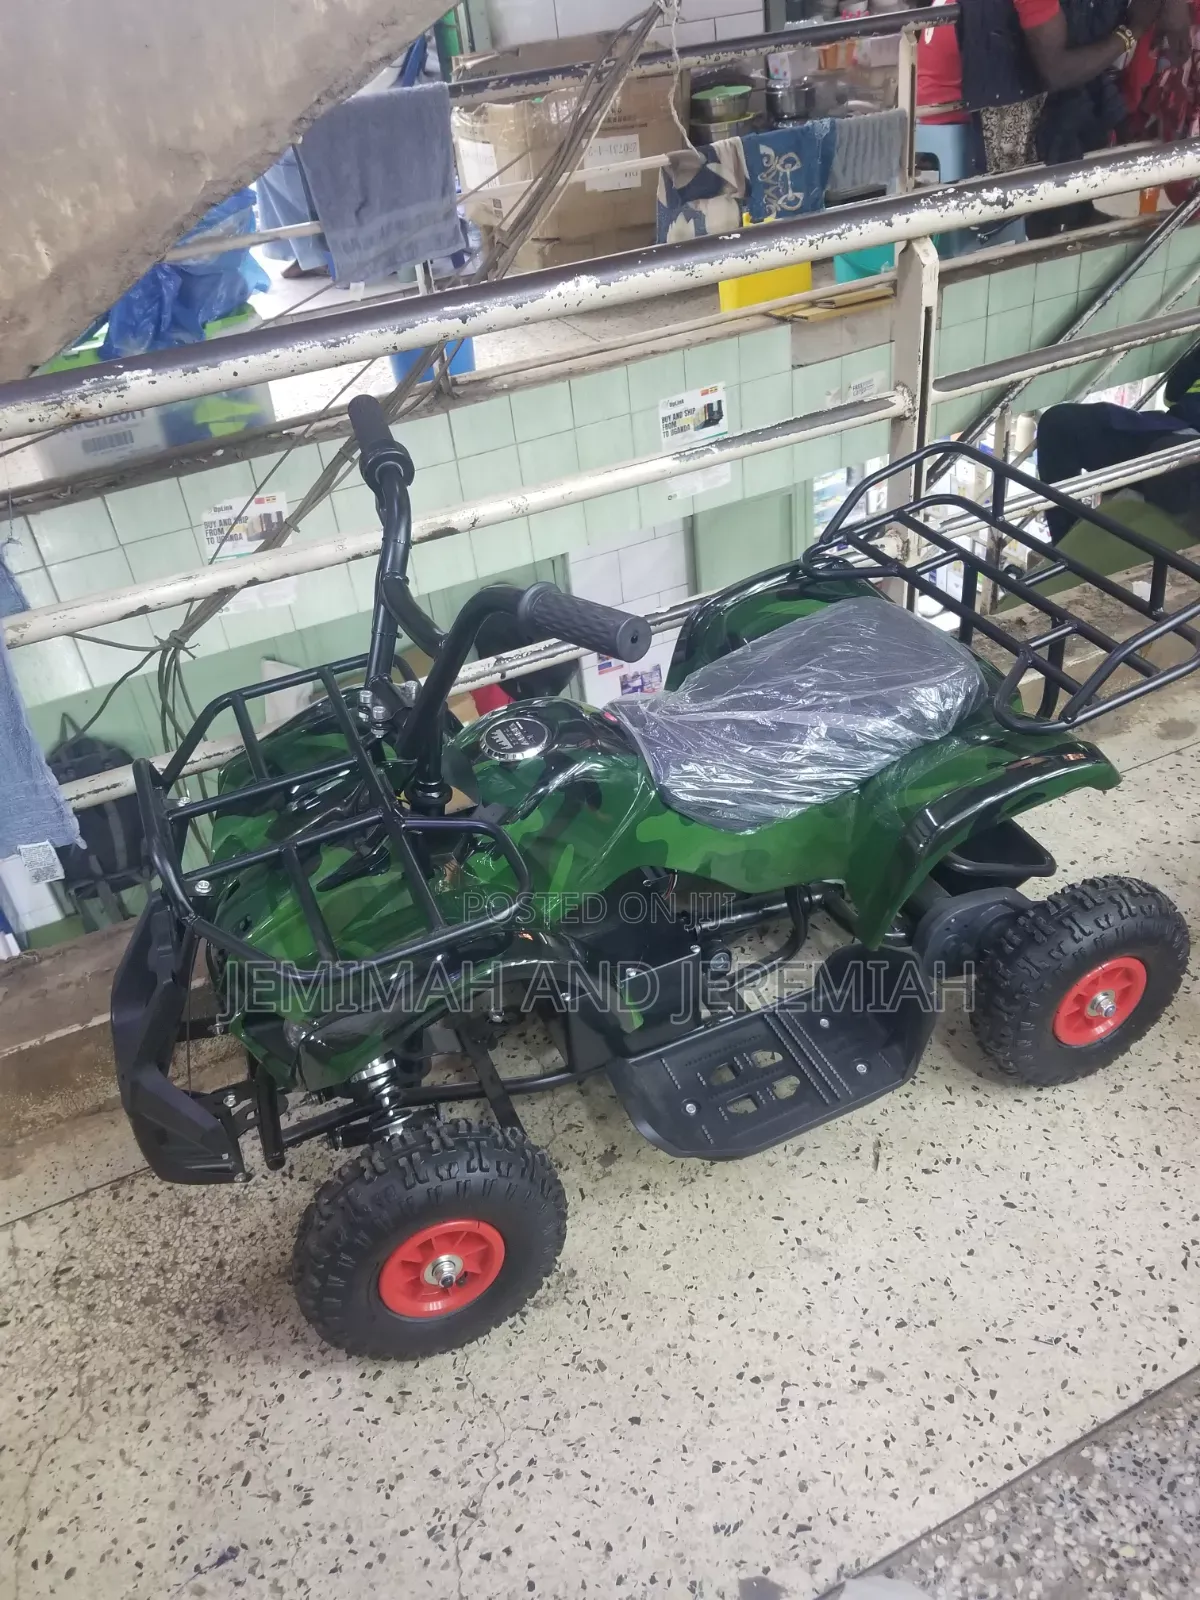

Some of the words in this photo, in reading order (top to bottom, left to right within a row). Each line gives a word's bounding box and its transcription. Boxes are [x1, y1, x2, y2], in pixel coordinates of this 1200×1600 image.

[661, 415, 671, 424] BUY
[673, 412, 683, 421] AND
[684, 408, 695, 417] SHIP
[662, 421, 677, 431] FROM
[663, 431, 670, 439] TO
[671, 424, 690, 436] UGANDA
[203, 521, 217, 529] BUY
[218, 518, 231, 527] AND
[205, 528, 225, 537] FROM
[206, 537, 215, 545] TO
